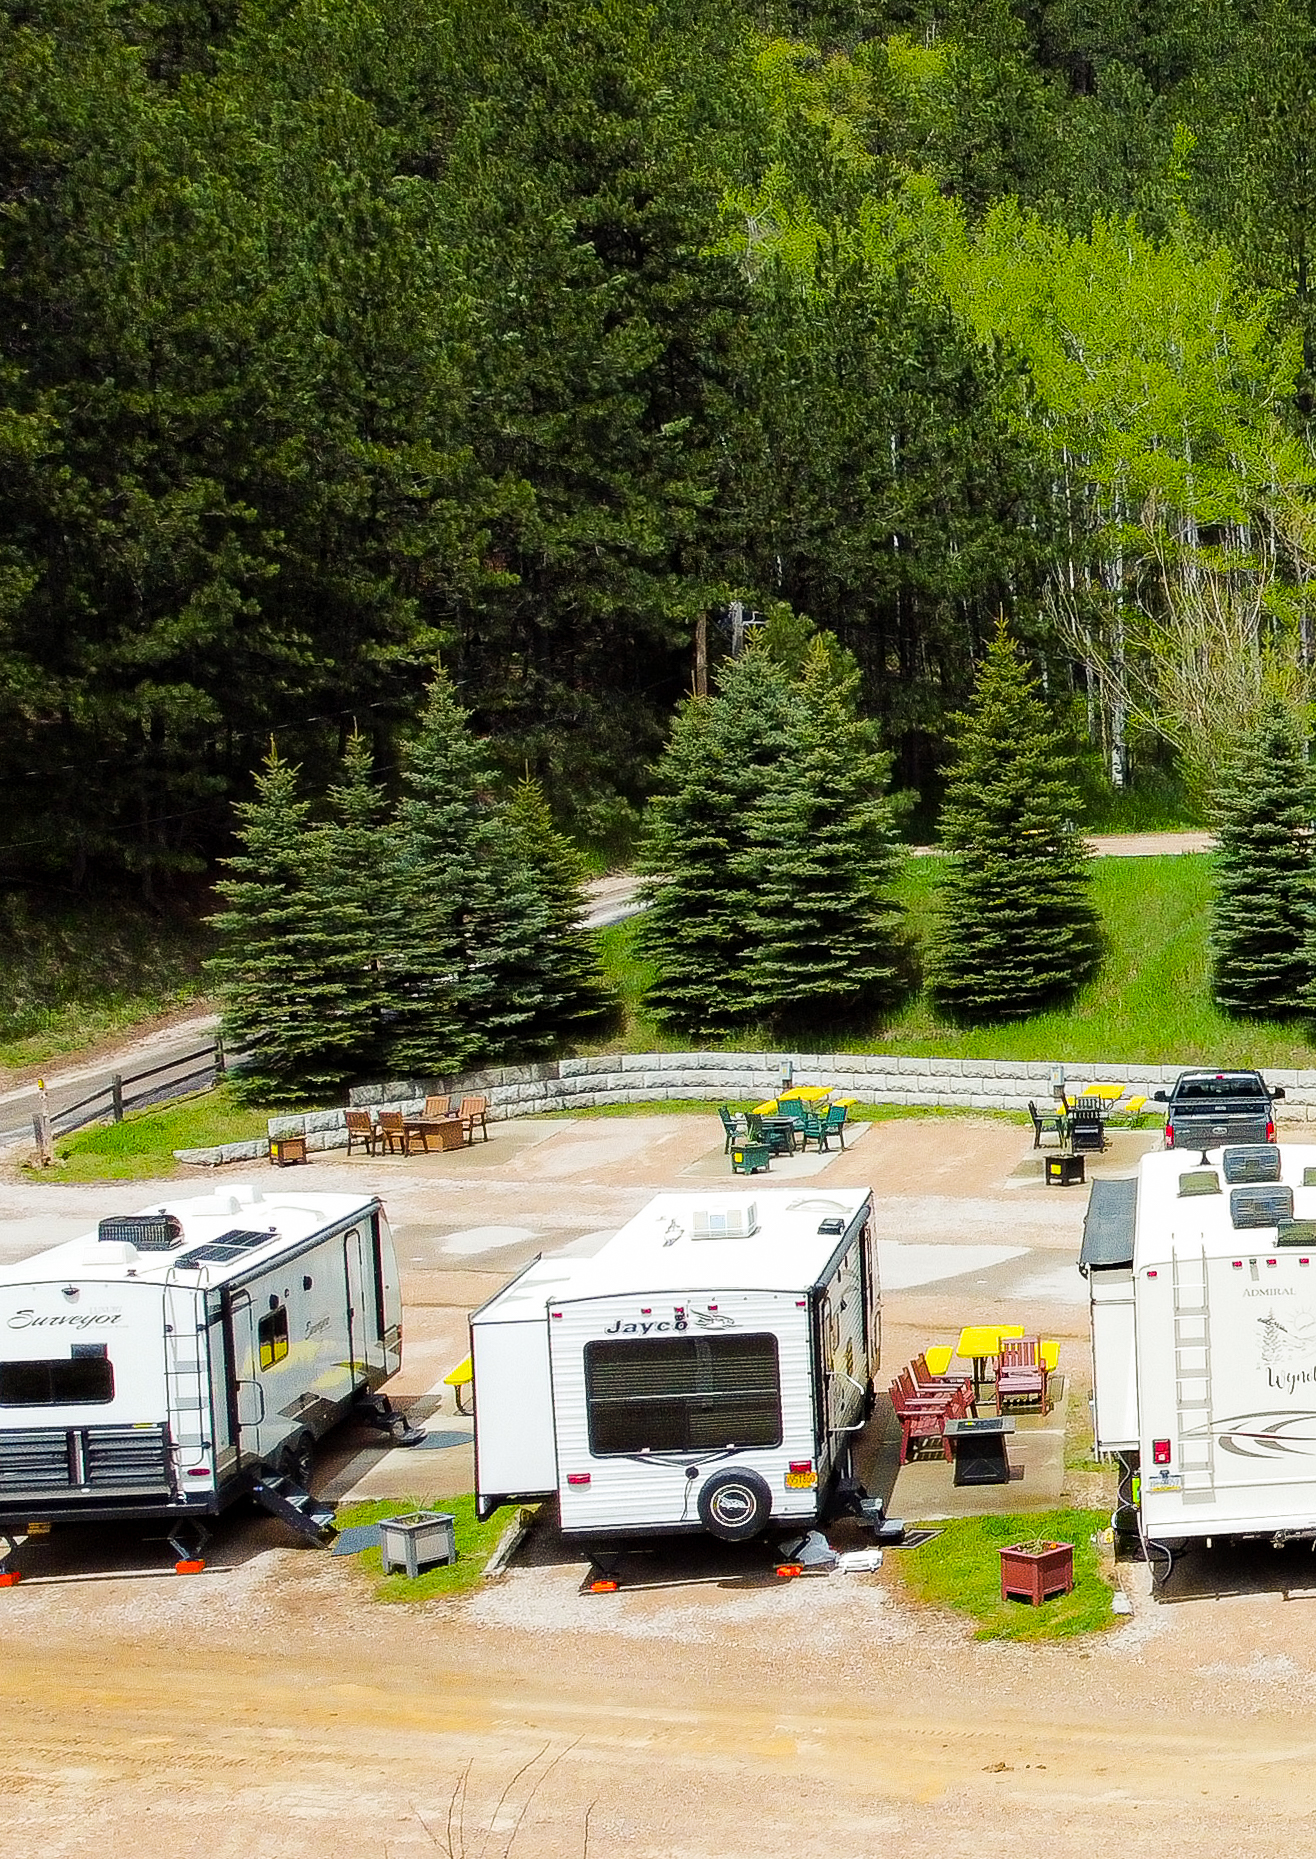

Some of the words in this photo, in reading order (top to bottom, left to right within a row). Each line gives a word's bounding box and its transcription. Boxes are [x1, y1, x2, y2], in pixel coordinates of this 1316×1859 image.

[1242, 1288, 1296, 1297] ADMIRAL
[7, 1309, 122, 1330] Surveyor
[606, 1320, 688, 1334] Jayco
